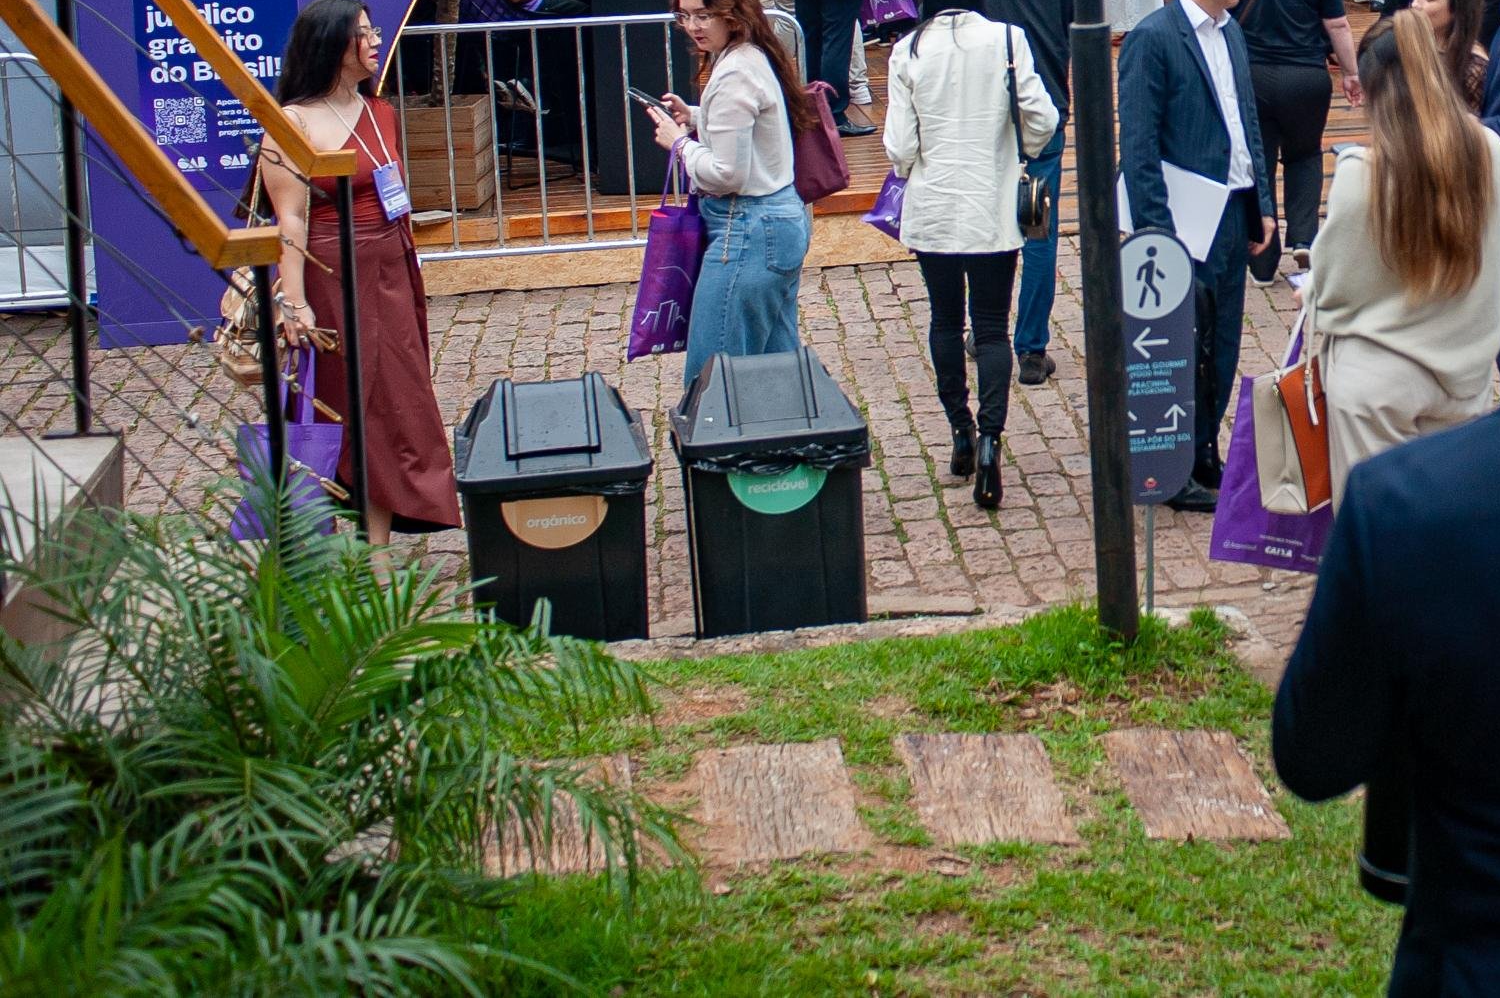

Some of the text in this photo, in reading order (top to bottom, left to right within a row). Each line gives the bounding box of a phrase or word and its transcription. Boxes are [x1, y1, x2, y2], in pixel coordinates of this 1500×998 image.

[146, 2, 255, 34] judico
[148, 29, 263, 61] graito
[150, 61, 188, 84] do
[747, 478, 809, 496] reciclável
[526, 513, 588, 529] orgânico
